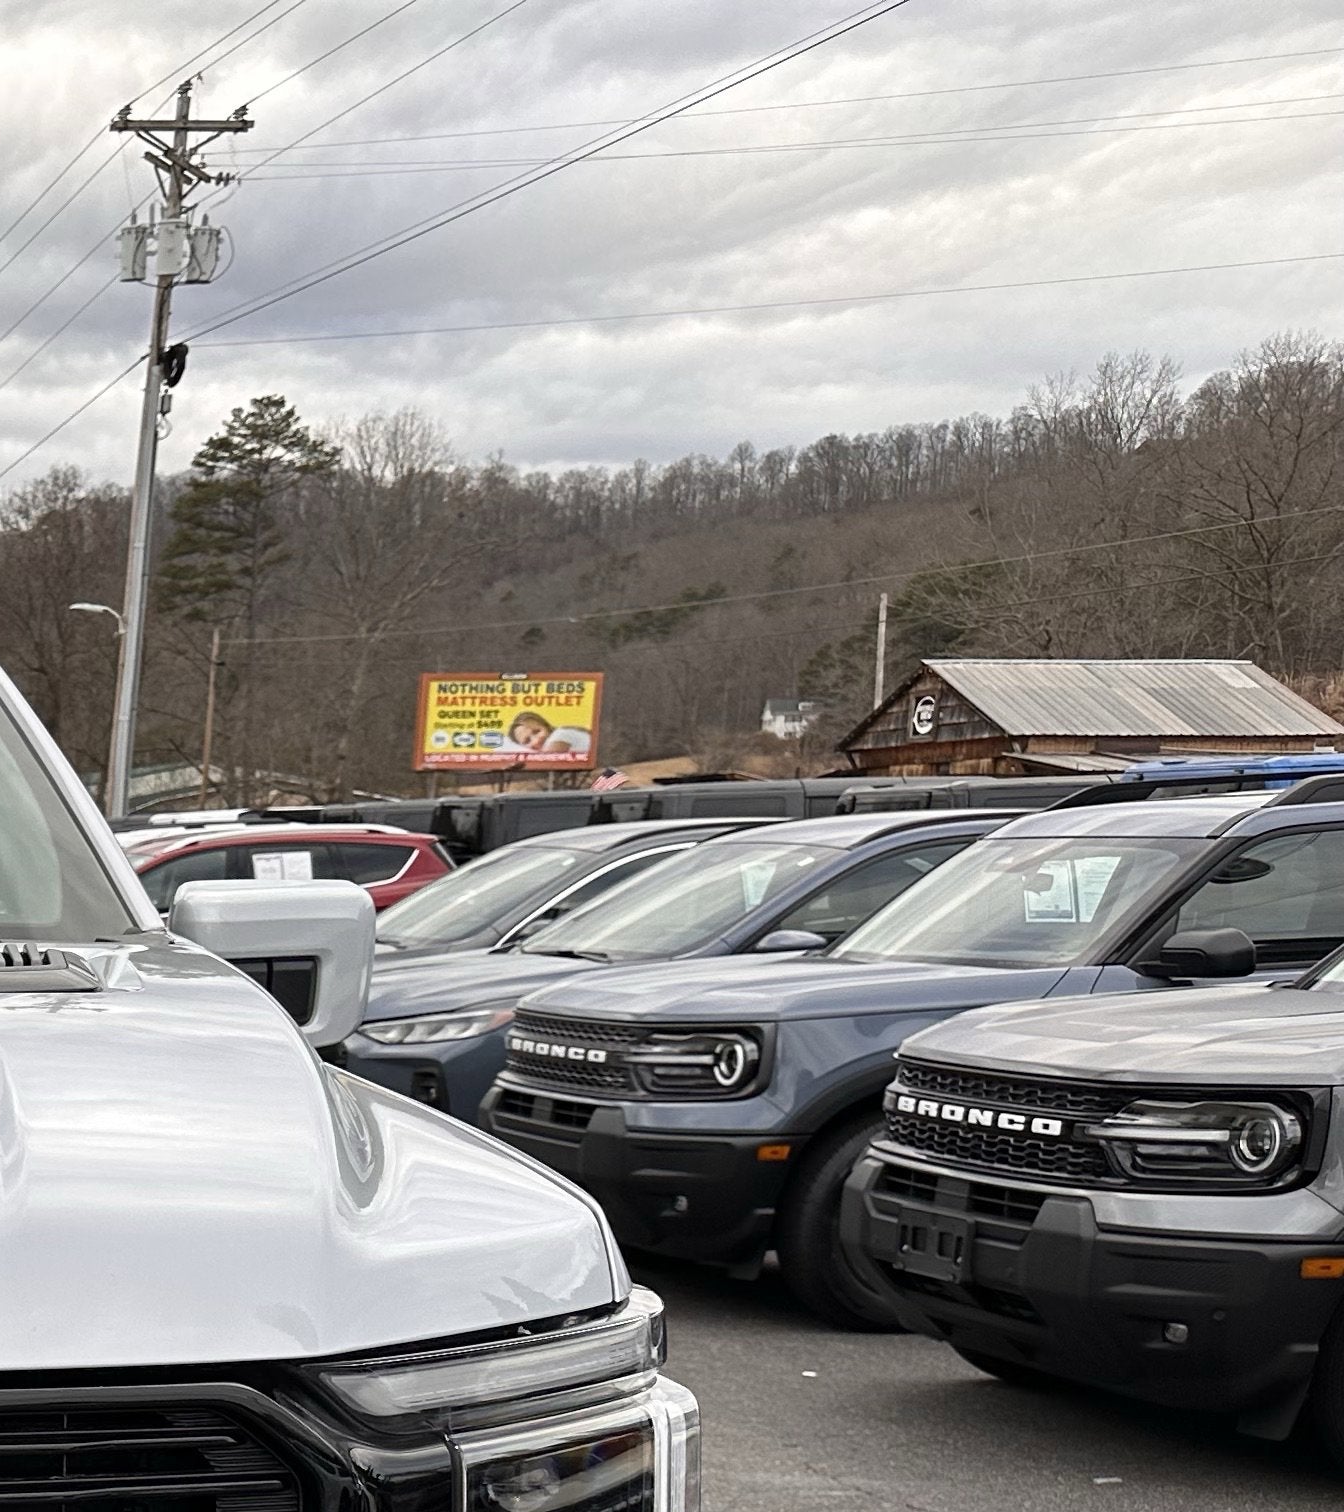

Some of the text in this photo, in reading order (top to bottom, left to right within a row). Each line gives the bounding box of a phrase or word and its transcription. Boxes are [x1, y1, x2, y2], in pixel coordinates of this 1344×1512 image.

[437, 681, 585, 695] NOTHING BUT BEDS
[436, 696, 584, 707] MATTRESS OUTLET
[437, 710, 499, 719] QUEEN SET
[511, 1038, 607, 1063] BRONCO
[897, 1096, 1062, 1136] BRONCO
